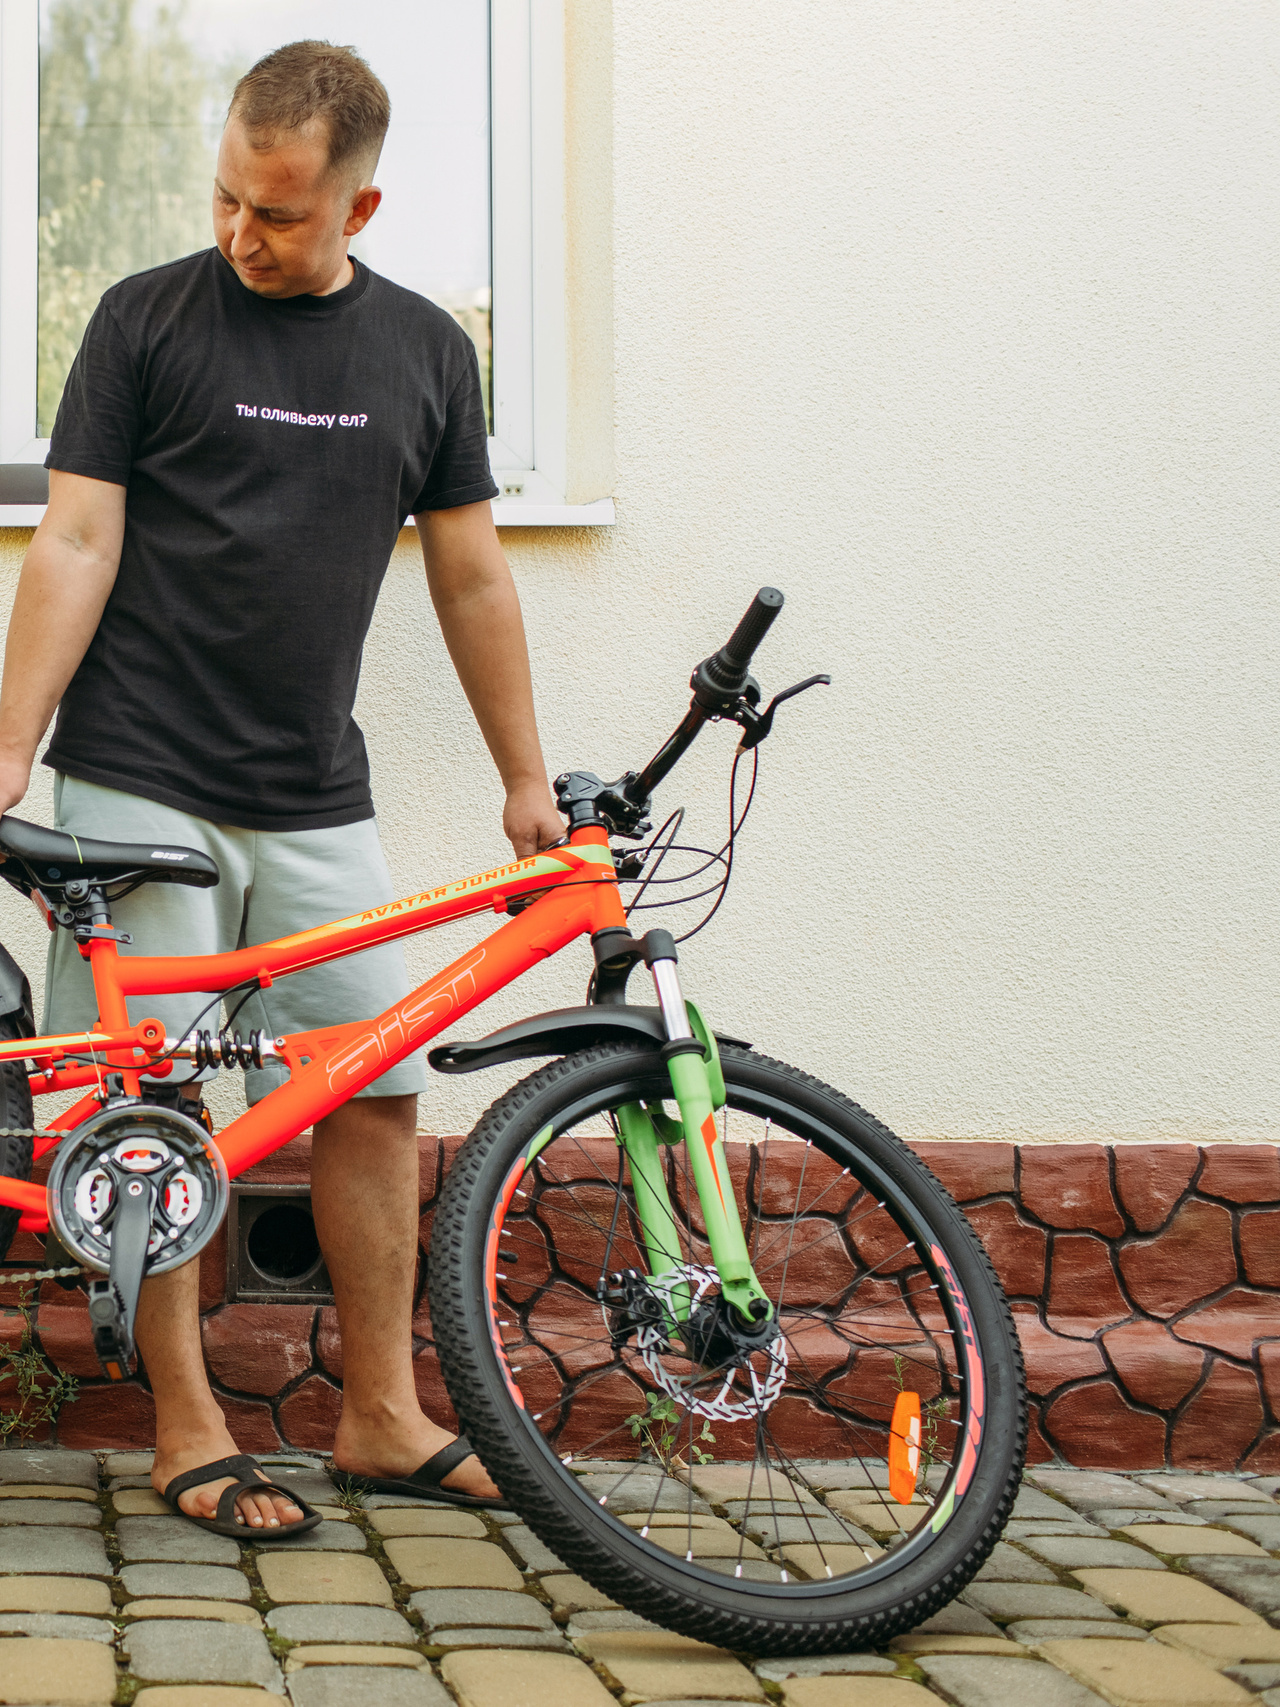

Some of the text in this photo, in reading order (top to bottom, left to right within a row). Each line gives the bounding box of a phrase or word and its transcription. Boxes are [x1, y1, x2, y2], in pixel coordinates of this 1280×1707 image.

[260, 407, 336, 430] оливьеху
[338, 413, 369, 428] ел?
[360, 858, 537, 923] AVATAR JUNIOR
